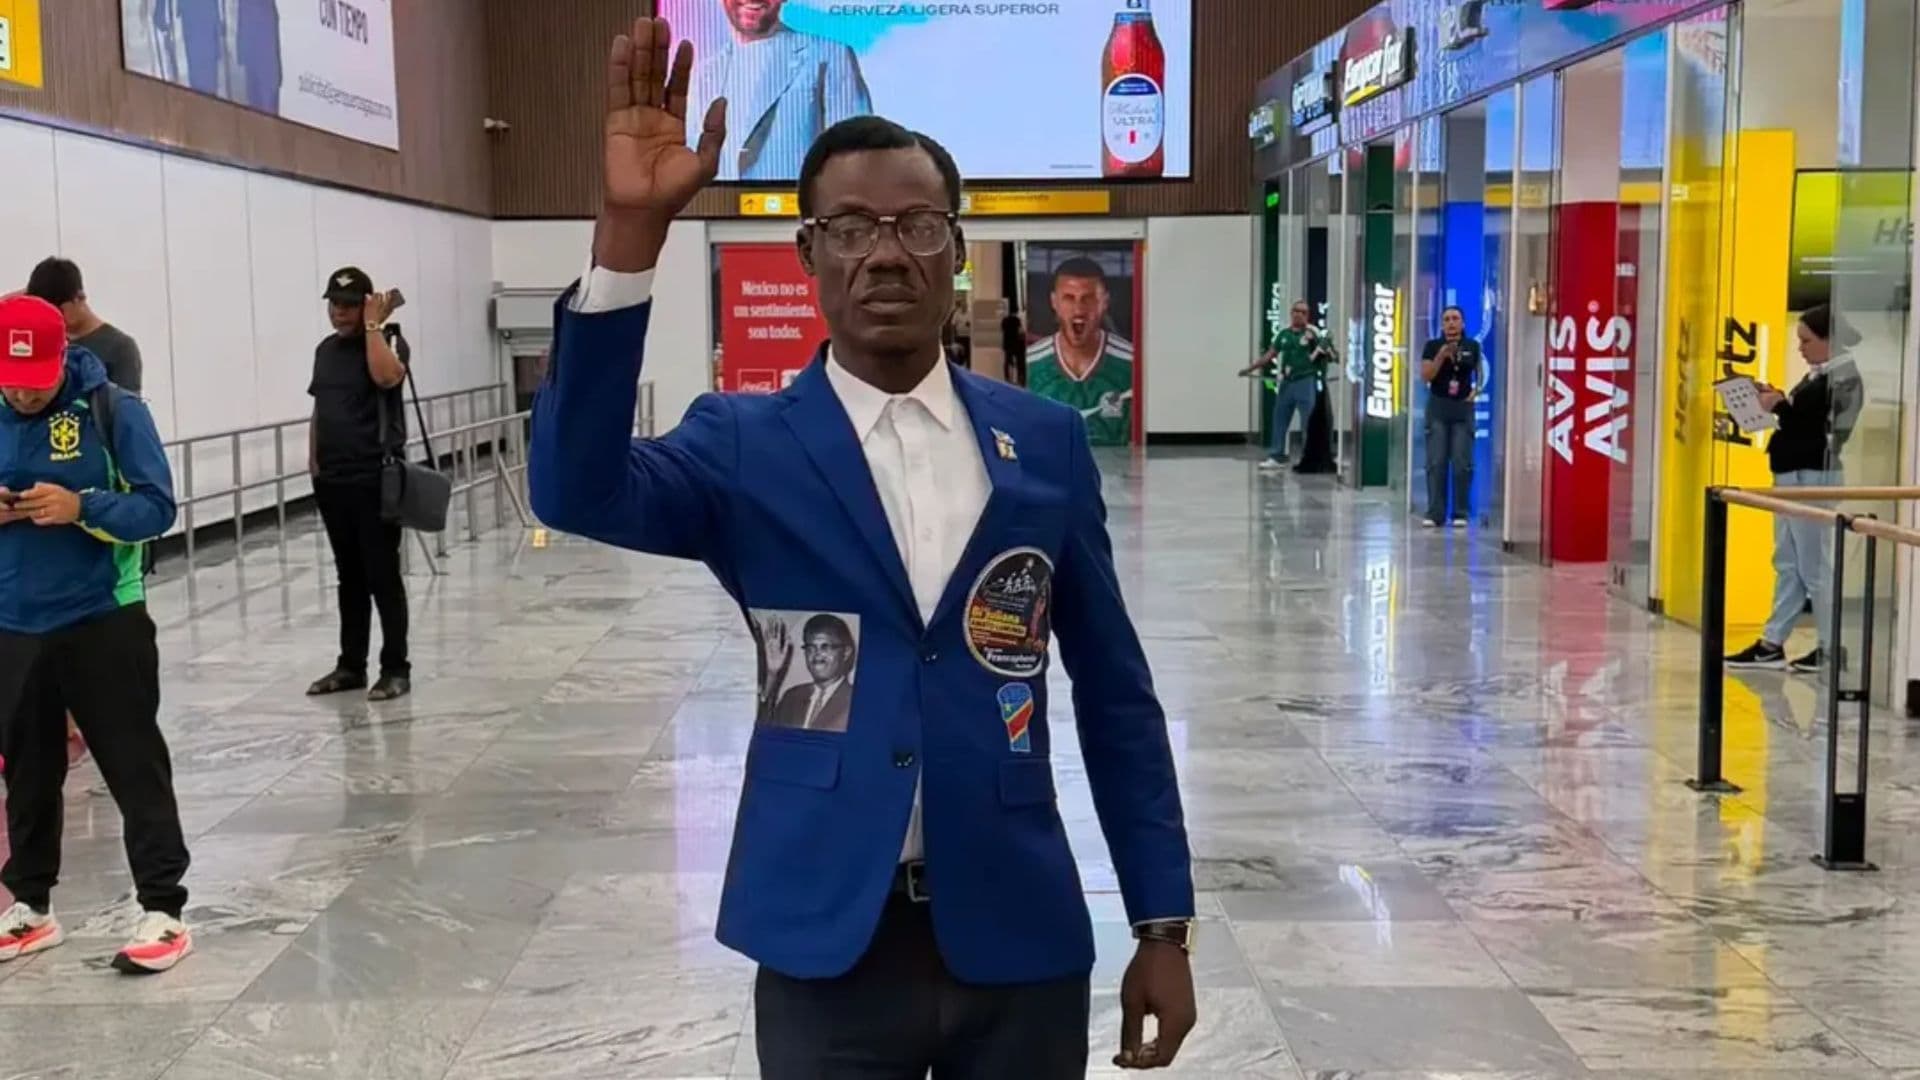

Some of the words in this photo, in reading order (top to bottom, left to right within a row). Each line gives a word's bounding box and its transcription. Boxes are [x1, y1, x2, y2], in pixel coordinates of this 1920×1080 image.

[828, 4, 907, 17] CERVEZA
[911, 4, 972, 16] LIGERA
[974, 3, 1060, 15] SUPERIOR
[1367, 282, 1396, 419] Europcar
[1547, 315, 1577, 465] AVIS
[1712, 316, 1757, 447] Hrtz
